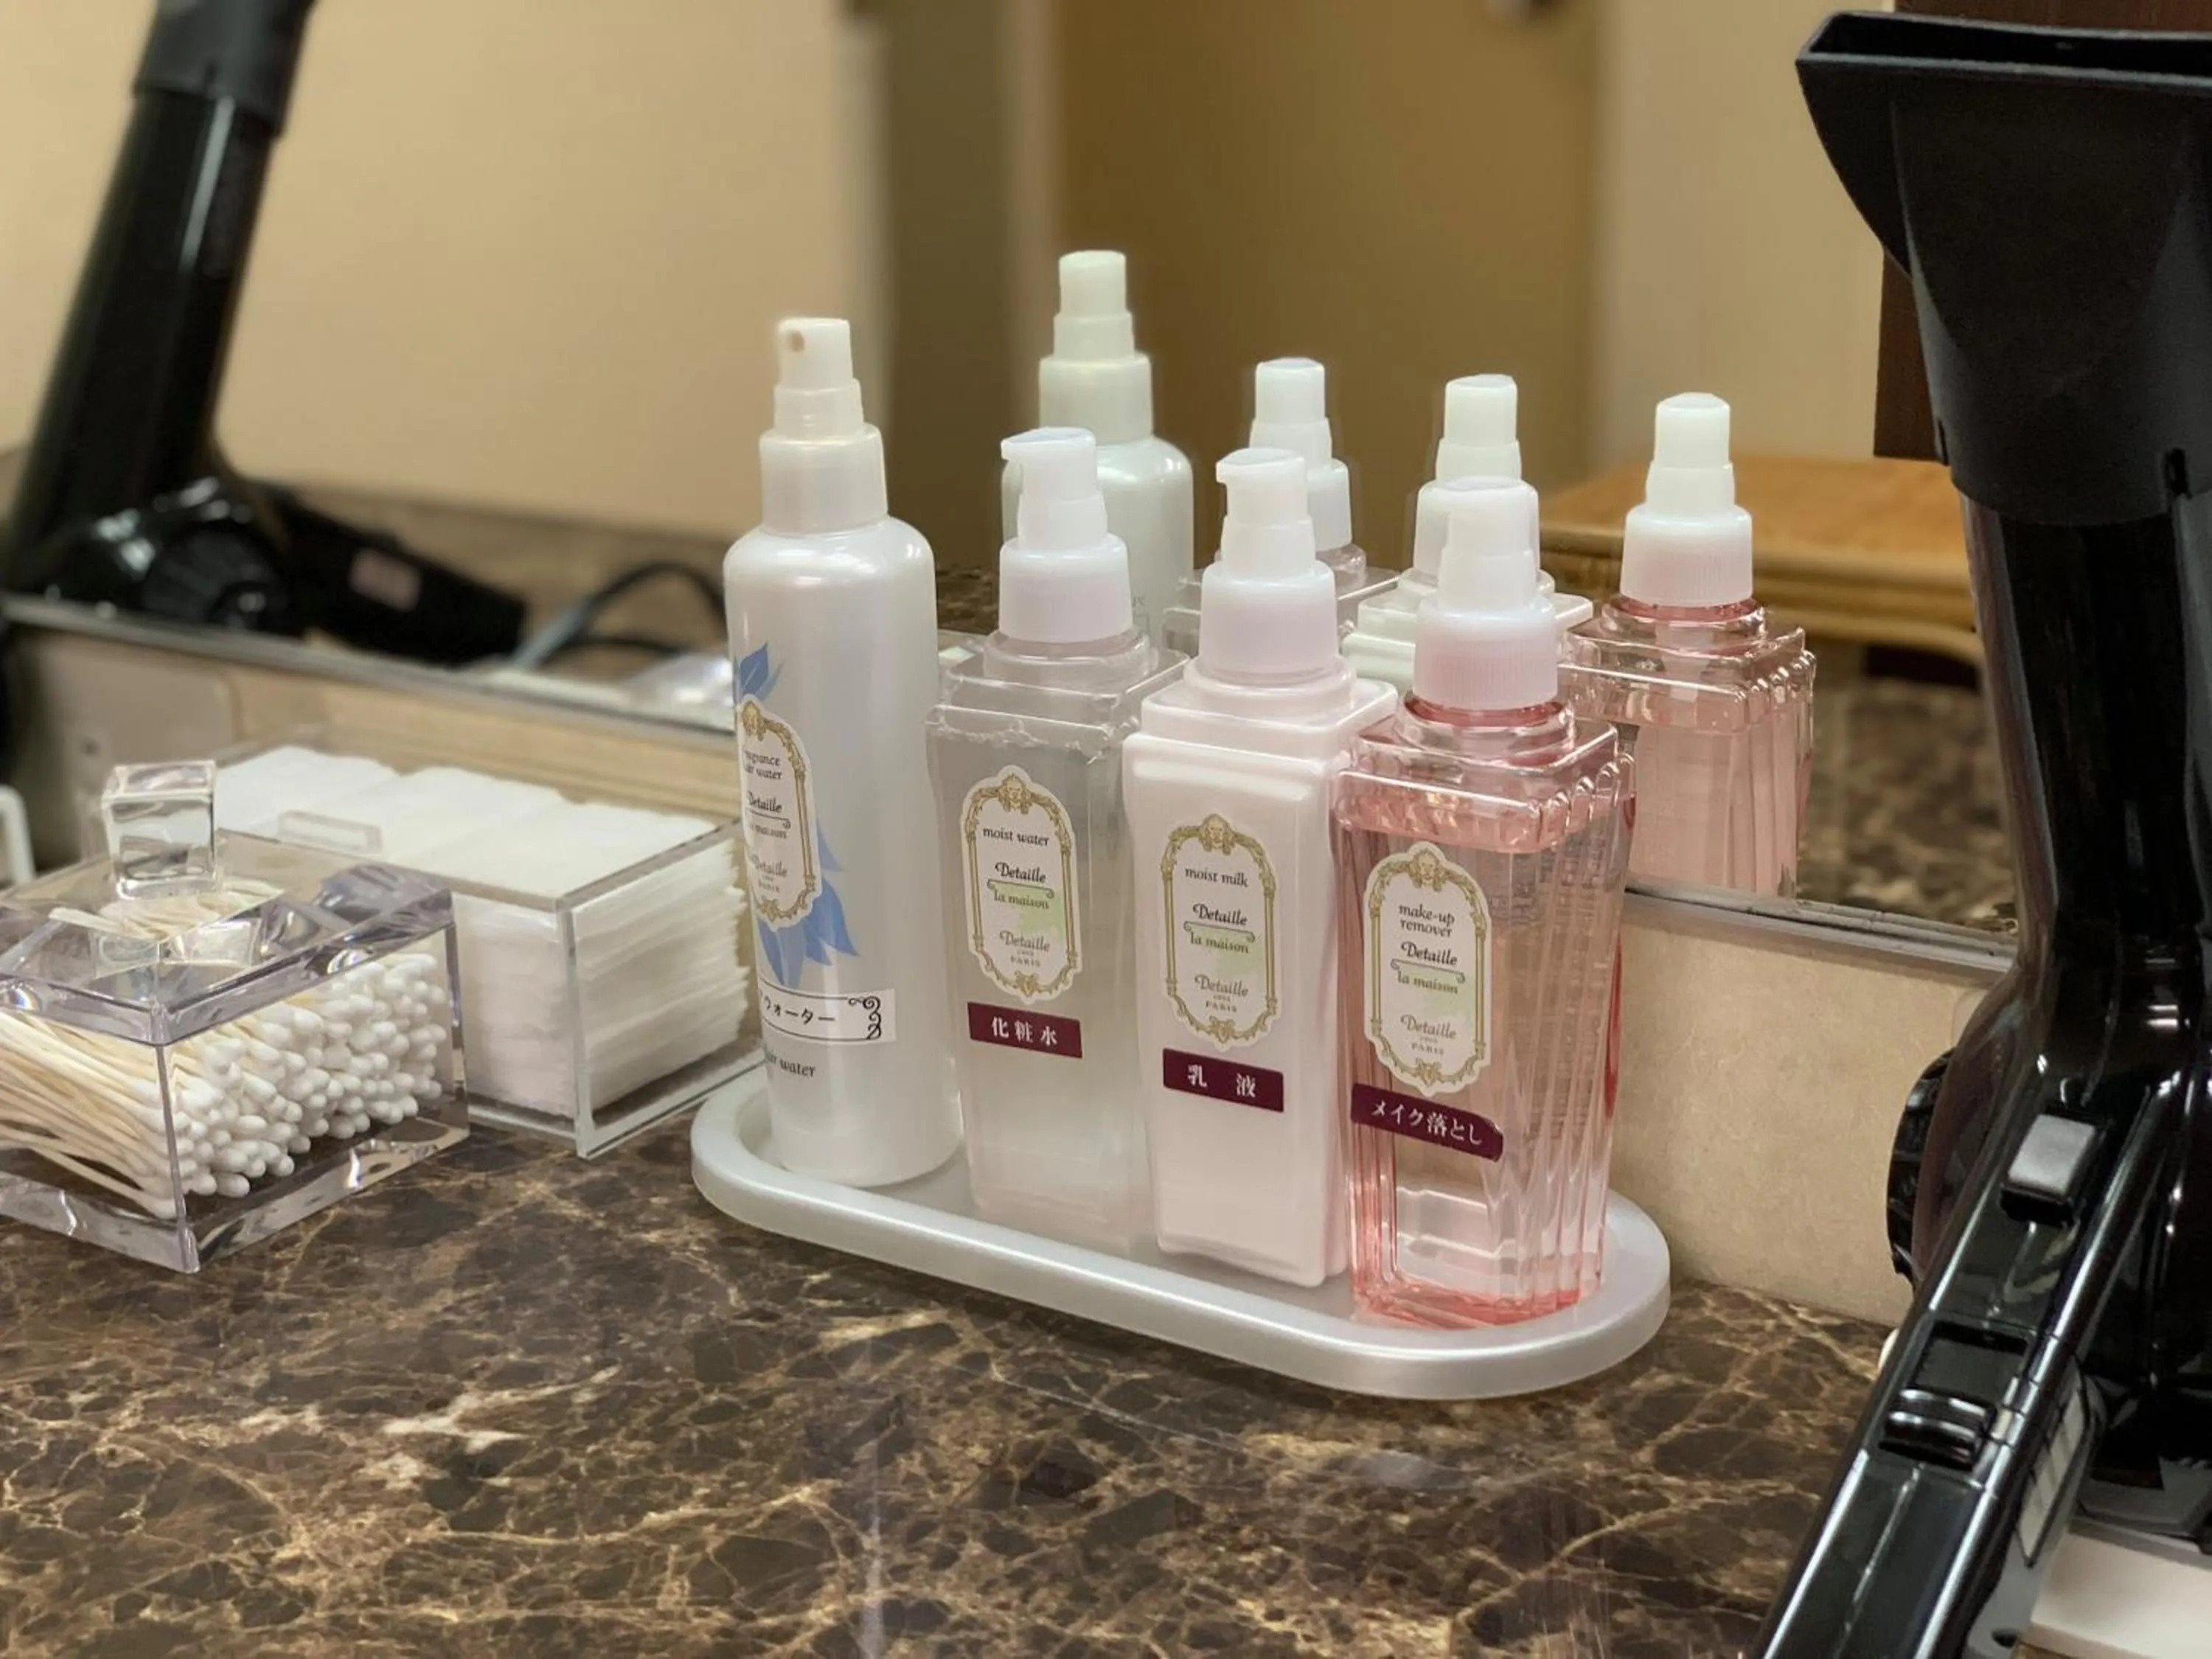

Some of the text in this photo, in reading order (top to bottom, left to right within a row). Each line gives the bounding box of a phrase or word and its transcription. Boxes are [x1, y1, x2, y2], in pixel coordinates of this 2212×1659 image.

[756, 768, 782, 779] water
[983, 827, 1049, 846] moist water
[995, 861, 1046, 883] Detaille
[1185, 867, 1248, 888] moist milk
[1008, 895, 1049, 910] maison
[1192, 902, 1248, 926] Detaille
[1399, 903, 1455, 927] make-up
[1400, 919, 1453, 938] remover
[1206, 937, 1249, 954] maison
[1401, 941, 1458, 966] Detaille
[1413, 978, 1458, 995] maison
[991, 1017, 1057, 1047] 化粧水
[779, 1058, 816, 1077] water
[1371, 1099, 1483, 1145] メイク落とし
